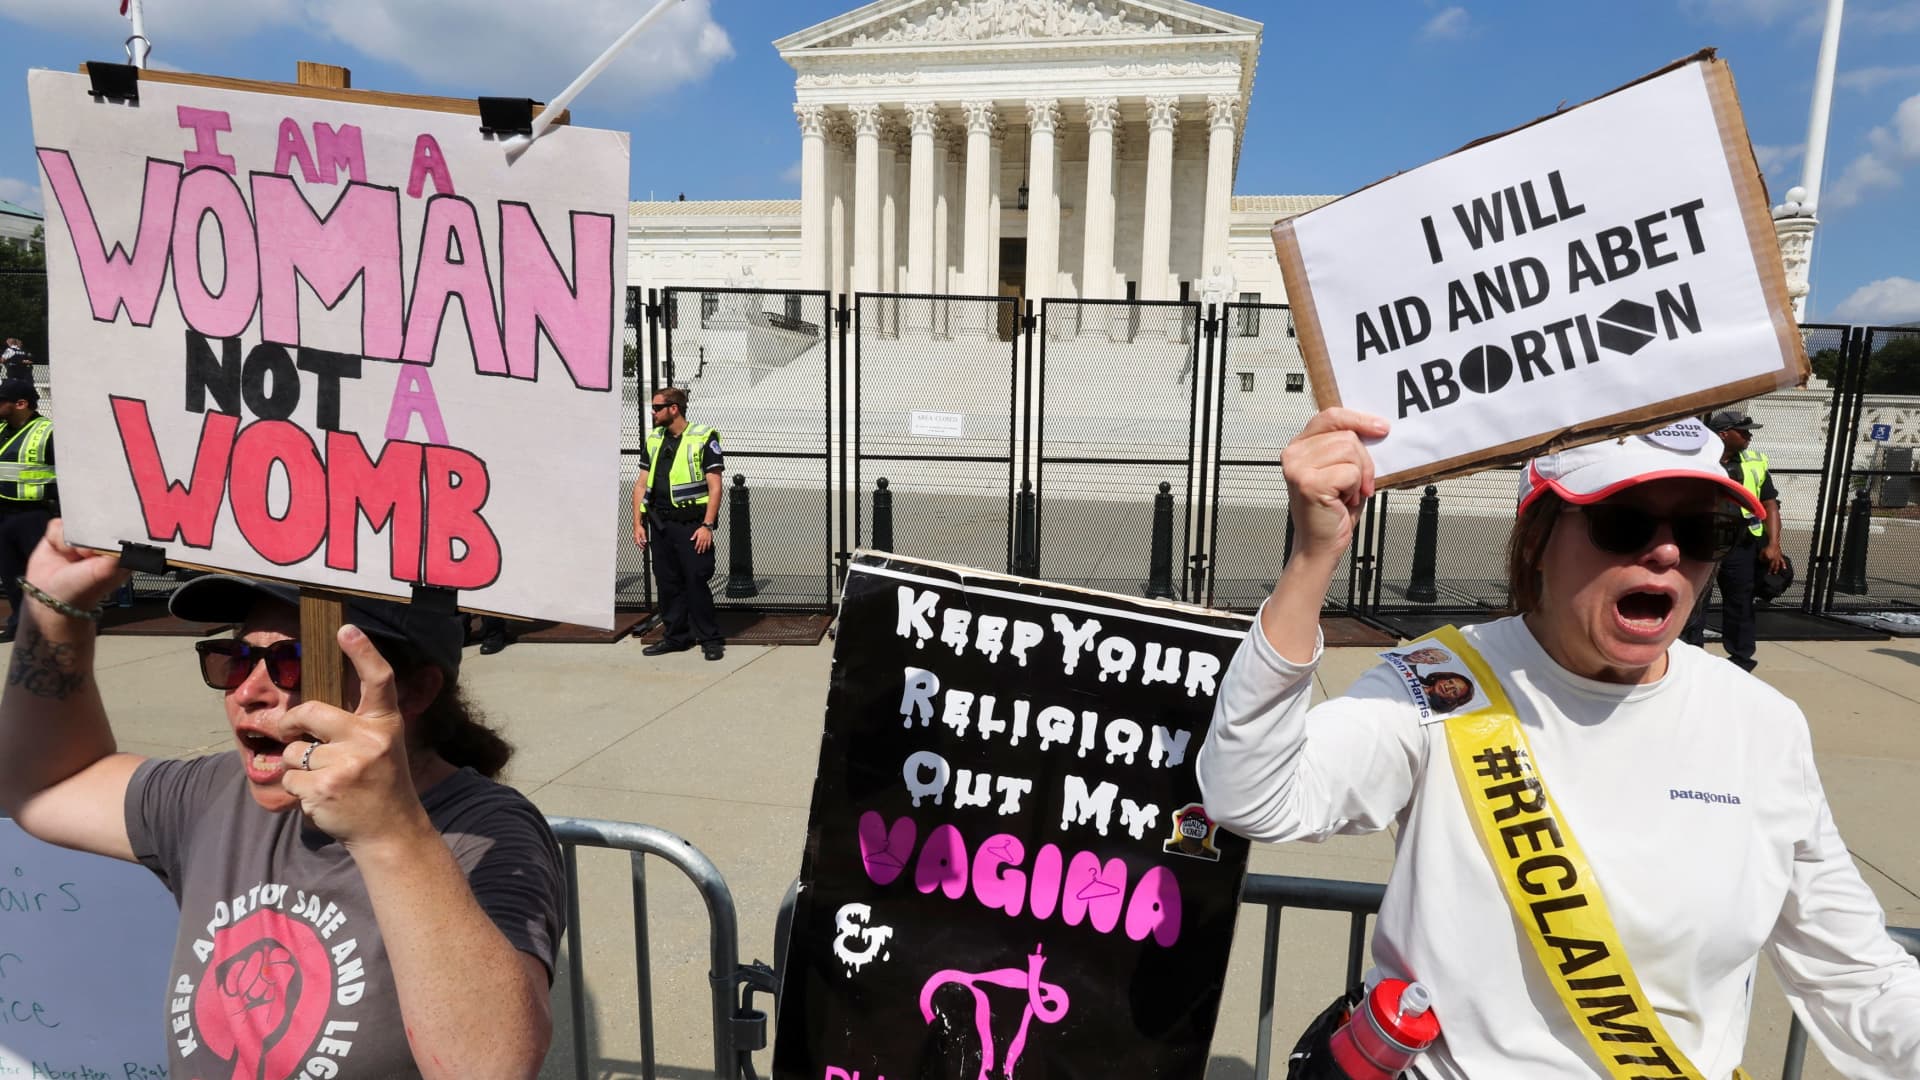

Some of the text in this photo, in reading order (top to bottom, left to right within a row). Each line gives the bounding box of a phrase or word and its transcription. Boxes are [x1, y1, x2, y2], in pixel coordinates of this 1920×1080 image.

[177, 105, 454, 199] I AM A
[1420, 169, 1585, 265] I WILL
[36, 147, 614, 392] WOMAN
[1355, 198, 1706, 362] AID AND ABET
[185, 330, 449, 445] NOT A
[1396, 282, 1702, 419] ABORTION
[1654, 430, 1700, 438] BODIES
[1675, 424, 1702, 432] OUR
[108, 394, 501, 590] WOMB
[899, 666, 1192, 768] RELIGION
[1408, 678, 1430, 718] Harris
[1669, 789, 1741, 805] patagonia
[291, 890, 348, 939] SAFE
[858, 811, 1182, 948] VAGINA
[1473, 744, 1690, 1080] #RECLAIMT
[331, 938, 366, 1006] AND
[833, 902, 893, 978] &
[171, 973, 198, 1058] KEEP
[294, 1020, 359, 1080] LEG
